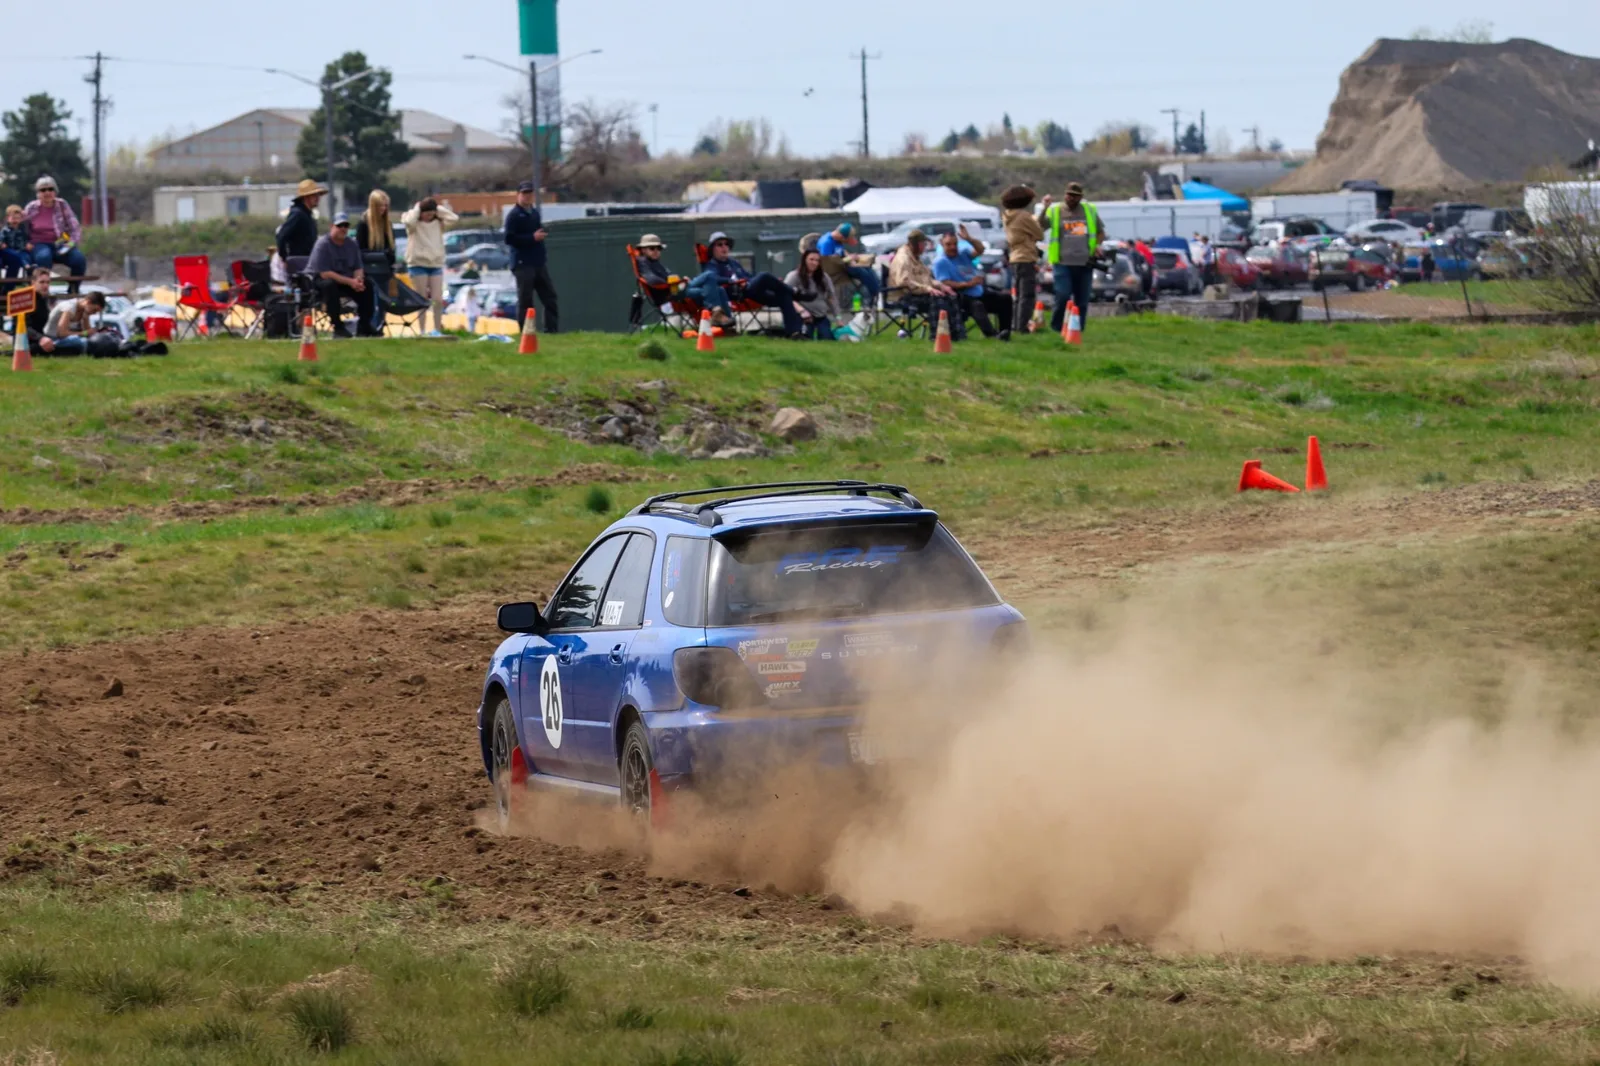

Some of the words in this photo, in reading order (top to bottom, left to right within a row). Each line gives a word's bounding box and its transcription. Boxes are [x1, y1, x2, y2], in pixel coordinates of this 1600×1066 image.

[784, 560, 884, 575] Racing
[739, 637, 788, 647] NORTHWEST
[760, 663, 789, 672] HAWK
[542, 670, 561, 731] 26
